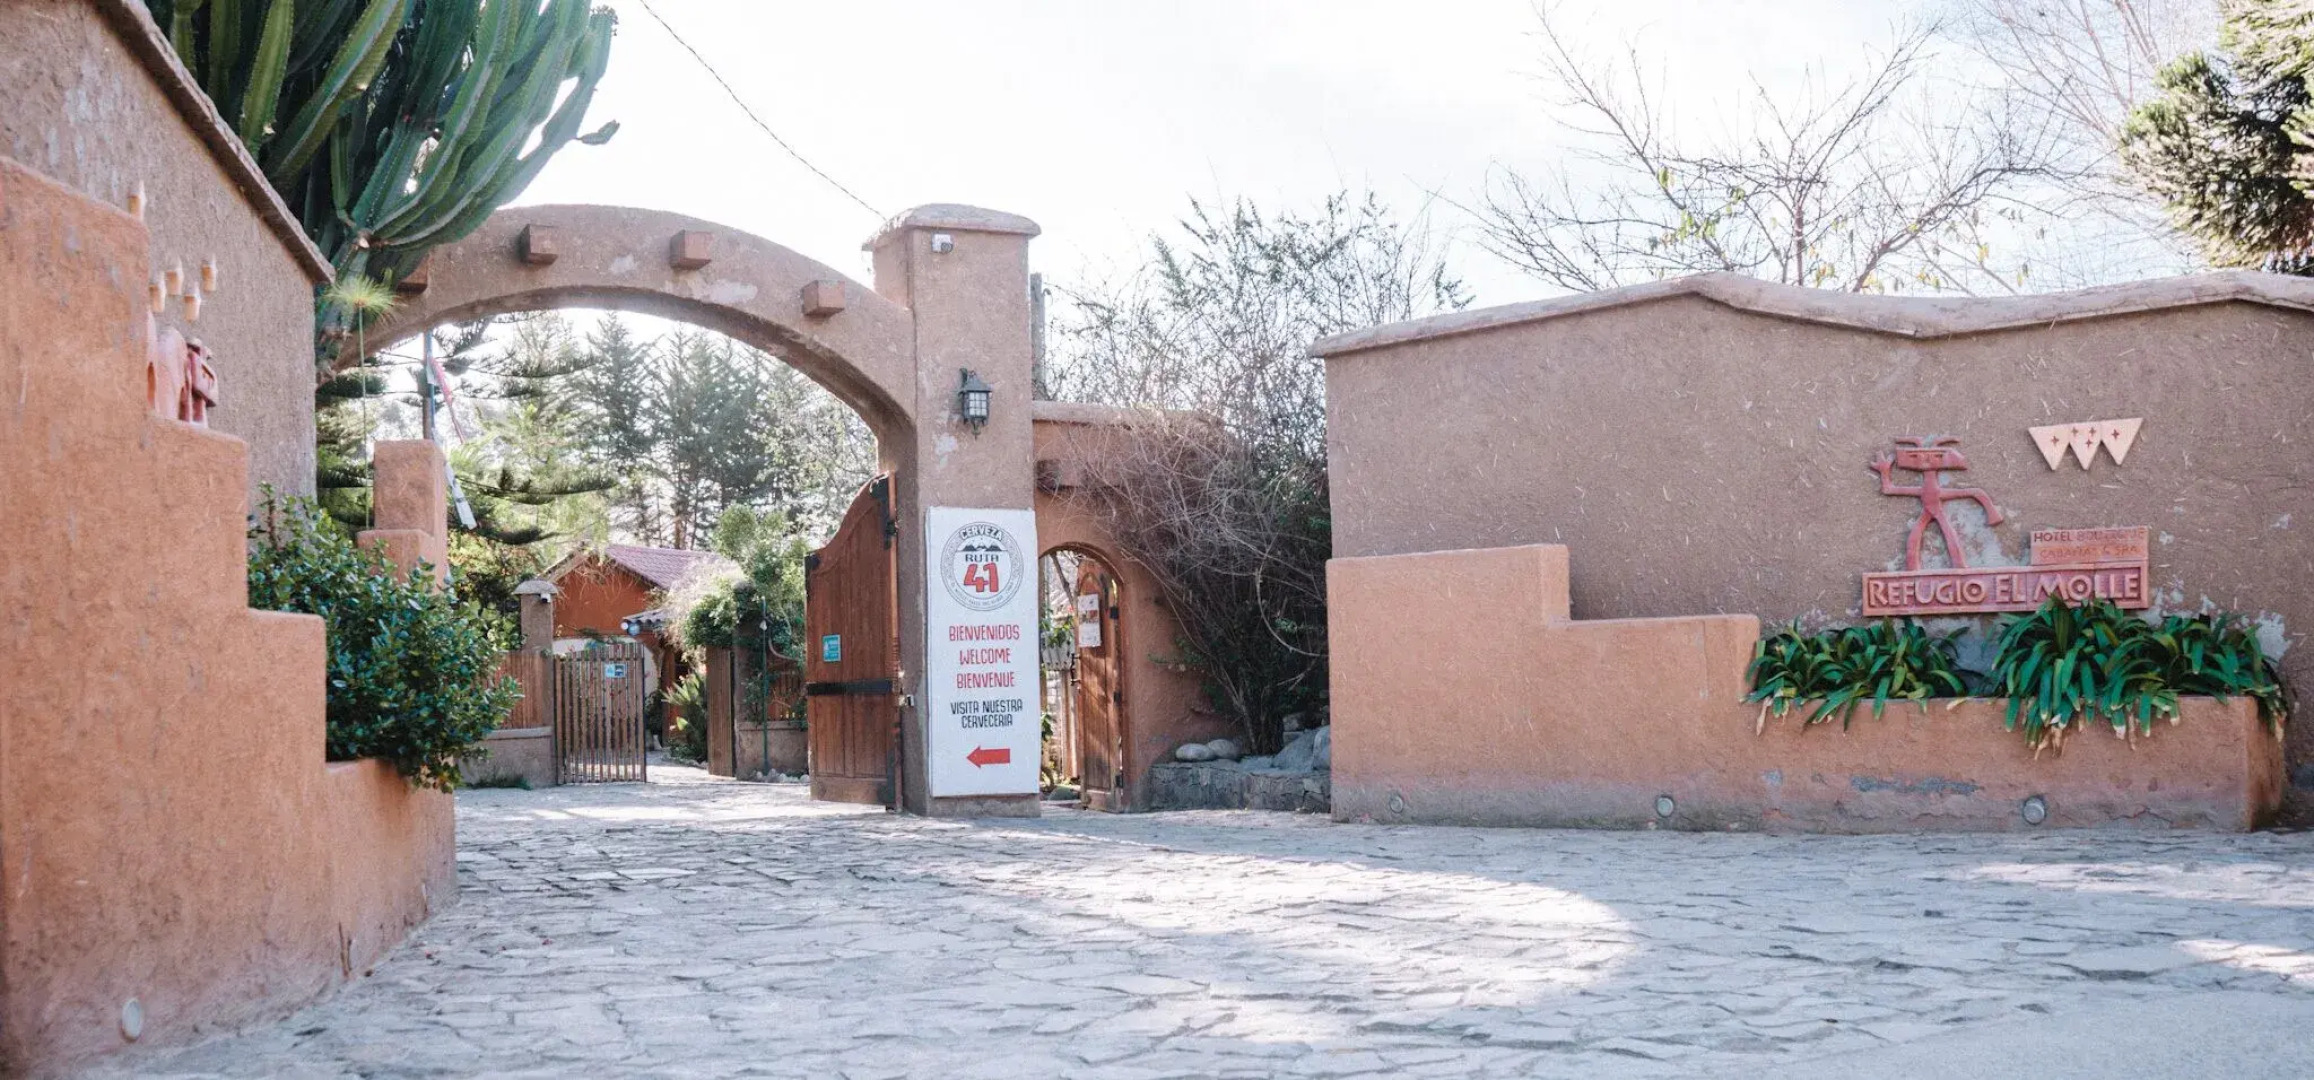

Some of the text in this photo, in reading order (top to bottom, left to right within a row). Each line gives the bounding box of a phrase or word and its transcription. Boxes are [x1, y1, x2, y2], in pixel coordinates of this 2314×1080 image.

[959, 524, 1004, 541] CERVEZA
[2034, 531, 2072, 542] HOTEL
[965, 554, 999, 562] RUTA
[963, 562, 999, 593] 41
[1869, 572, 2140, 607] REFUGIO EL MOLLE
[949, 624, 1020, 642] BIENVENIDOS
[959, 648, 1011, 665] WELCOME
[957, 671, 1015, 689] BIENVENUE
[950, 698, 1023, 715] VISITA NUESTRA
[961, 713, 1013, 729] CERVECERIA
